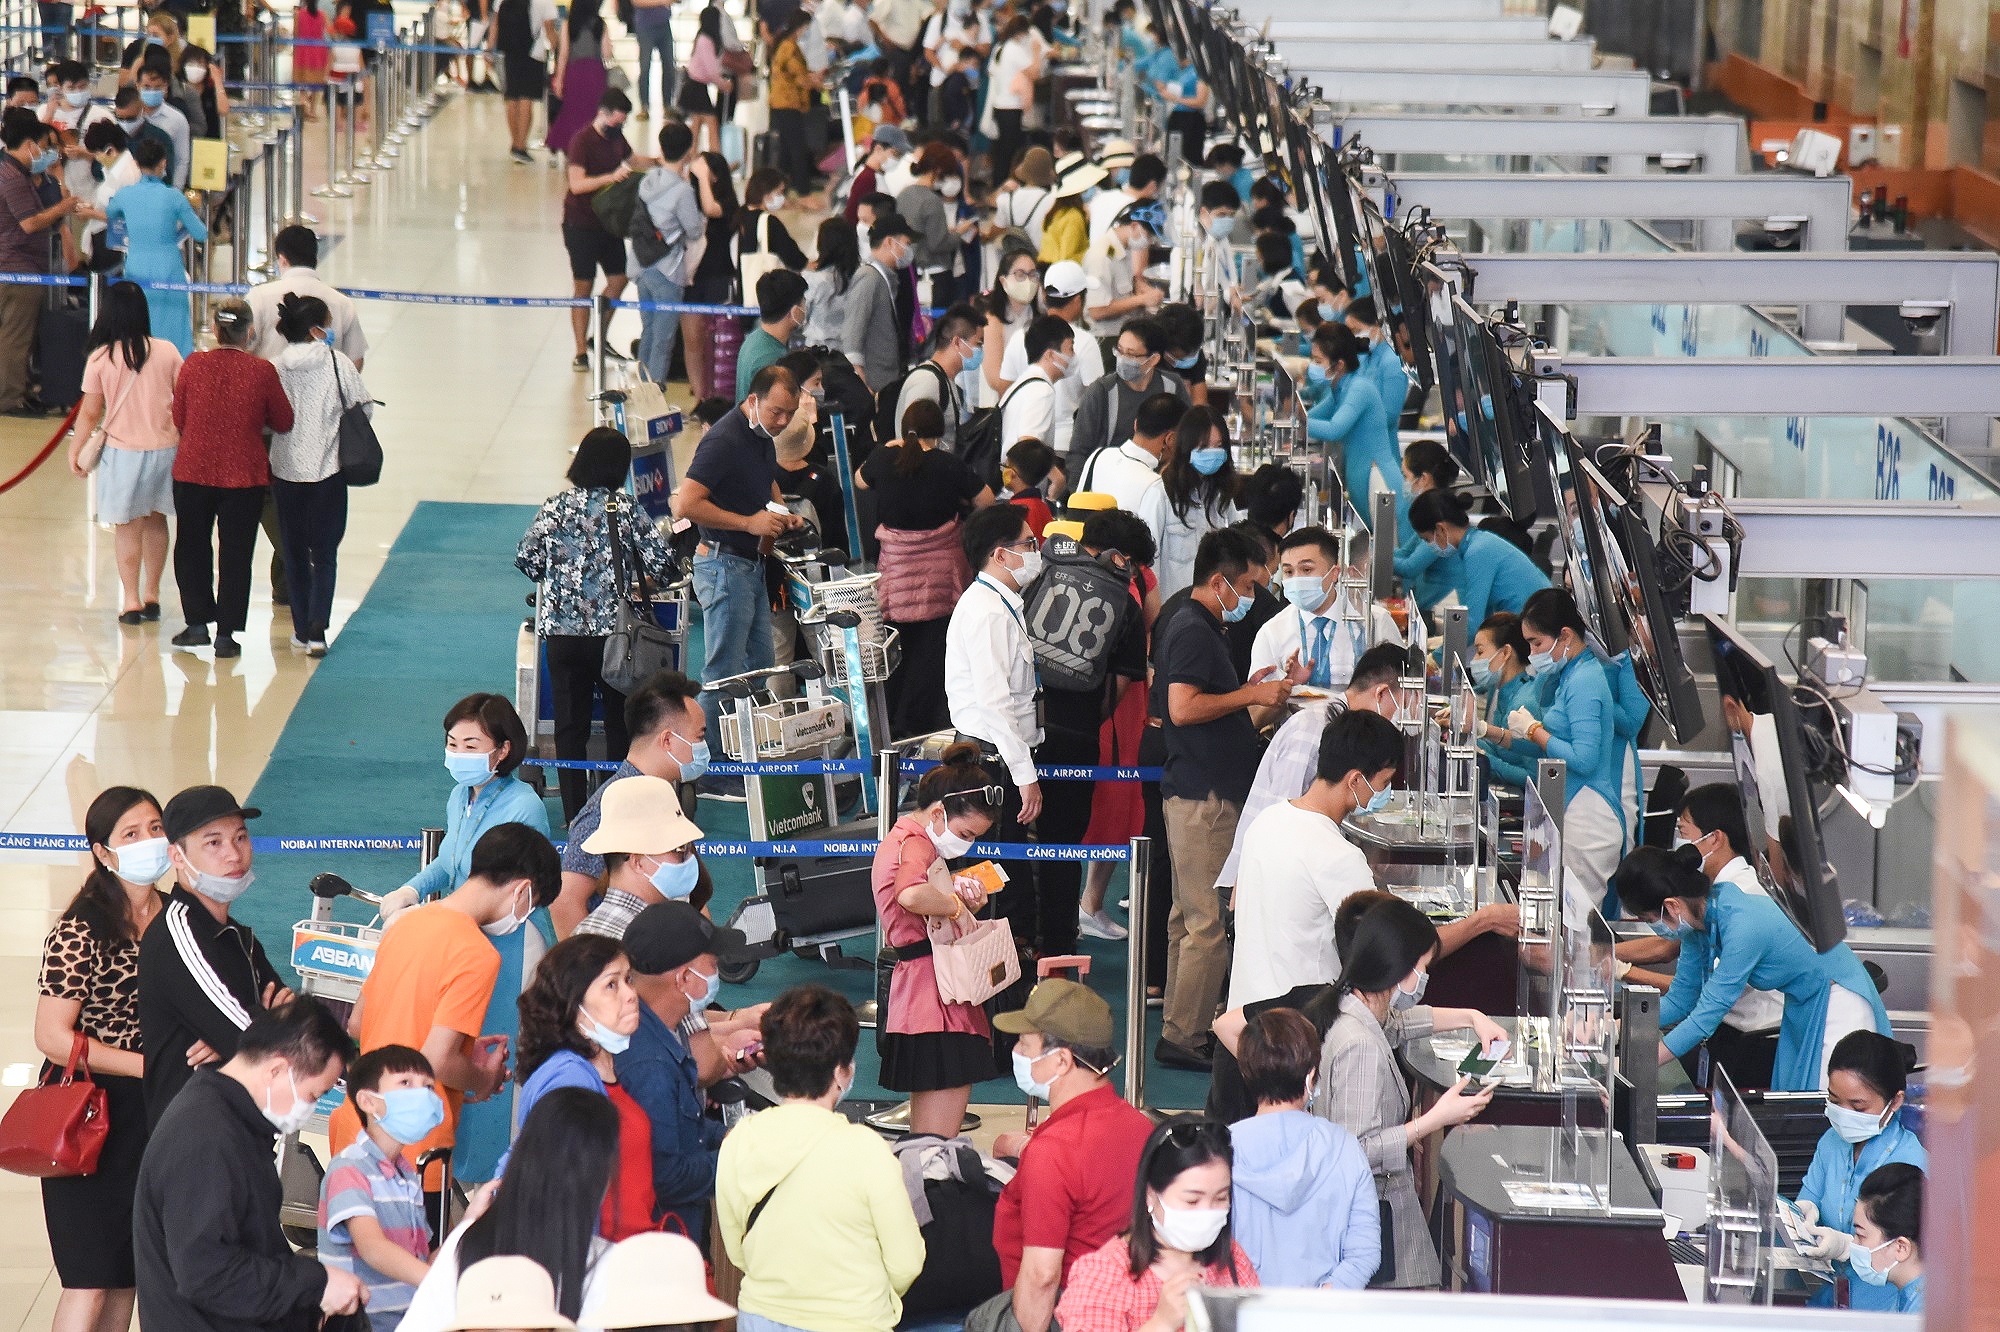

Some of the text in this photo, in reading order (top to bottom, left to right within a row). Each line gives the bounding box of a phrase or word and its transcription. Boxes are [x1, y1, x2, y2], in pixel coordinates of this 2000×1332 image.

[1031, 583, 1115, 660] 08
[758, 763, 800, 773] AIRPORT
[822, 762, 846, 772] N.I.A
[1052, 769, 1093, 778] AIRPORT
[1117, 769, 1140, 779] N.I.A
[768, 806, 823, 836] Vietcombank
[33, 836, 66, 849] HÀNG
[280, 839, 318, 850] NOIBAI
[319, 839, 404, 850] INTERNATIONAL
[772, 844, 798, 854] N.I.A
[823, 843, 859, 853] NOIBAI
[976, 845, 1127, 860] N.I.A CẢNG HÀNG KHÔNG
